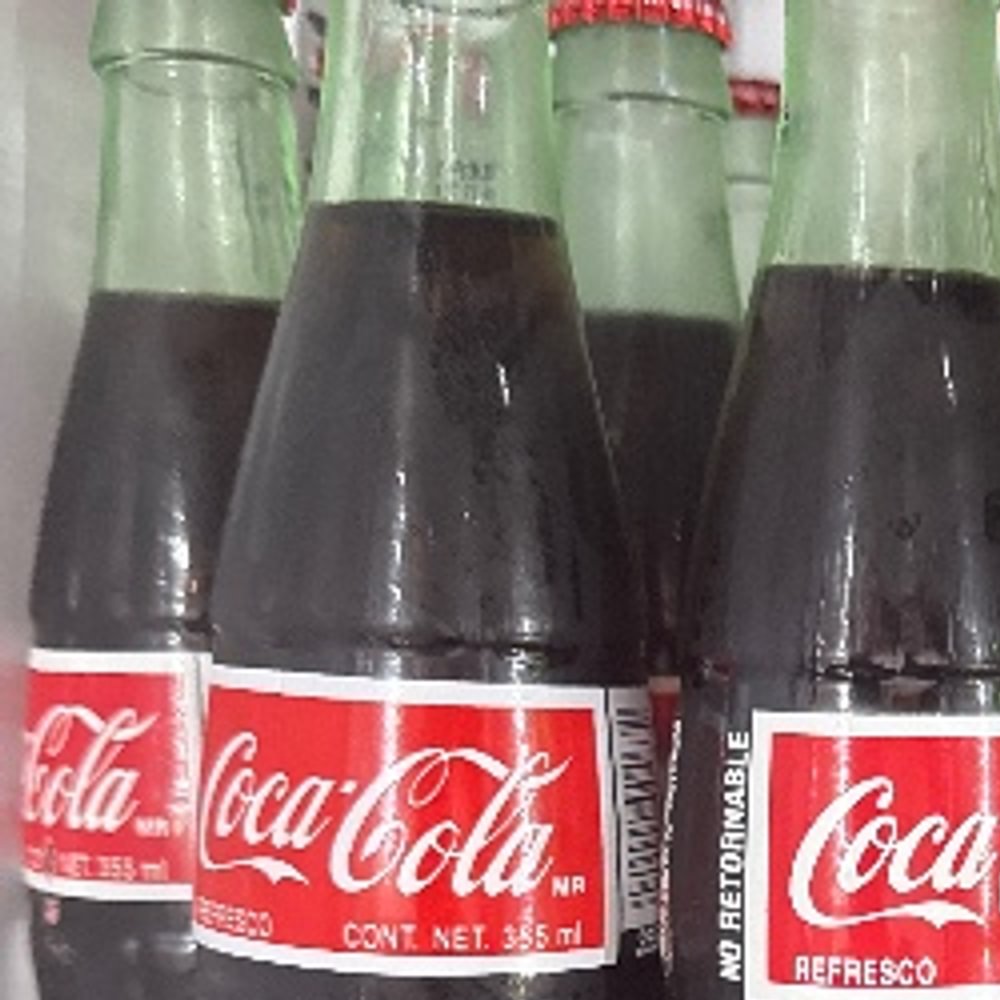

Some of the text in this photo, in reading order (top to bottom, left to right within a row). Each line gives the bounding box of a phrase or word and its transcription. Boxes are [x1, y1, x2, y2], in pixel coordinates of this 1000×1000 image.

[199, 732, 572, 896] Coca-Cola
[719, 731, 750, 982] NO RETORNABLE
[551, 876, 586, 897] NR
[502, 922, 549, 949] 355
[555, 920, 582, 946] ml
[794, 954, 938, 987] REFRESCO
